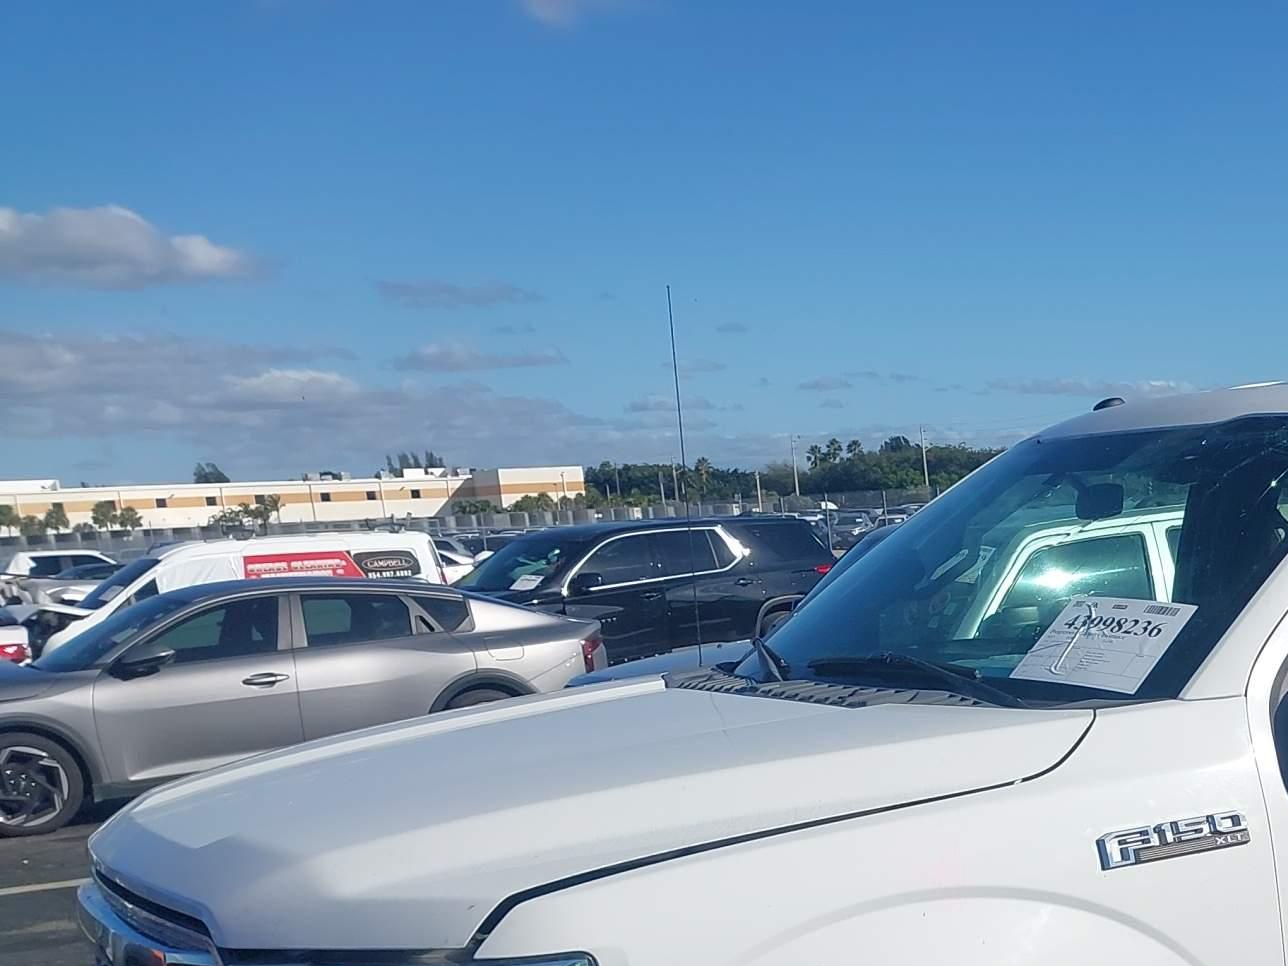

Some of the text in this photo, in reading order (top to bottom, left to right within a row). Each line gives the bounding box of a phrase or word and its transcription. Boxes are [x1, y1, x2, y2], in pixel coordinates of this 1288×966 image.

[367, 558, 406, 568] CAMPBELL
[1063, 614, 1168, 639] 43998236
[1096, 809, 1248, 871] F150
[1214, 834, 1244, 846] XLT
